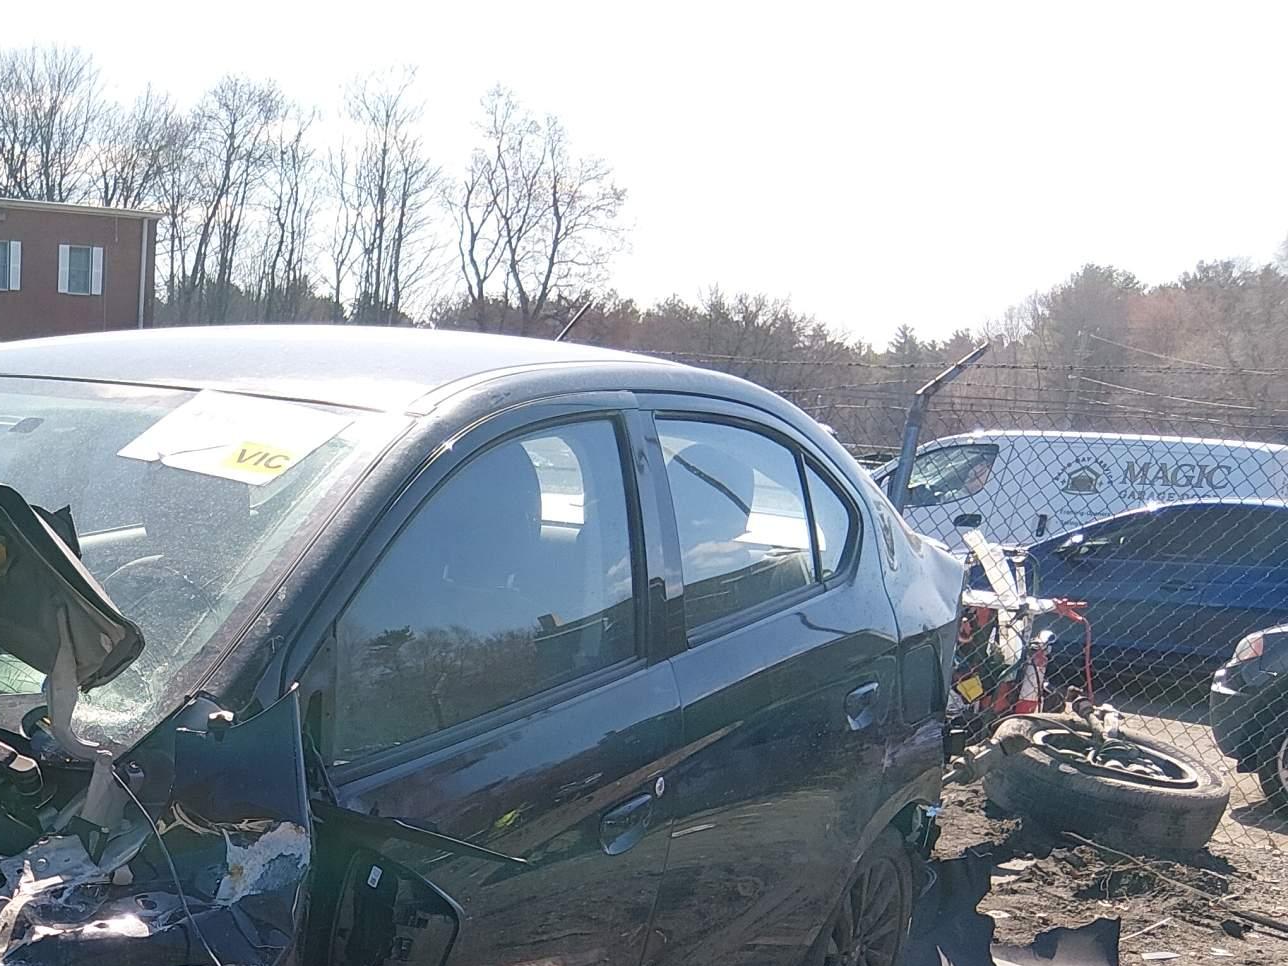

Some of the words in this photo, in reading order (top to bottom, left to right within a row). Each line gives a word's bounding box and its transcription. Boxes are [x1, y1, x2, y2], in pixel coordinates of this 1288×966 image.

[236, 448, 291, 470] VIC
[1120, 460, 1232, 490] MAGIC
[1119, 489, 1177, 502] GARAGE
